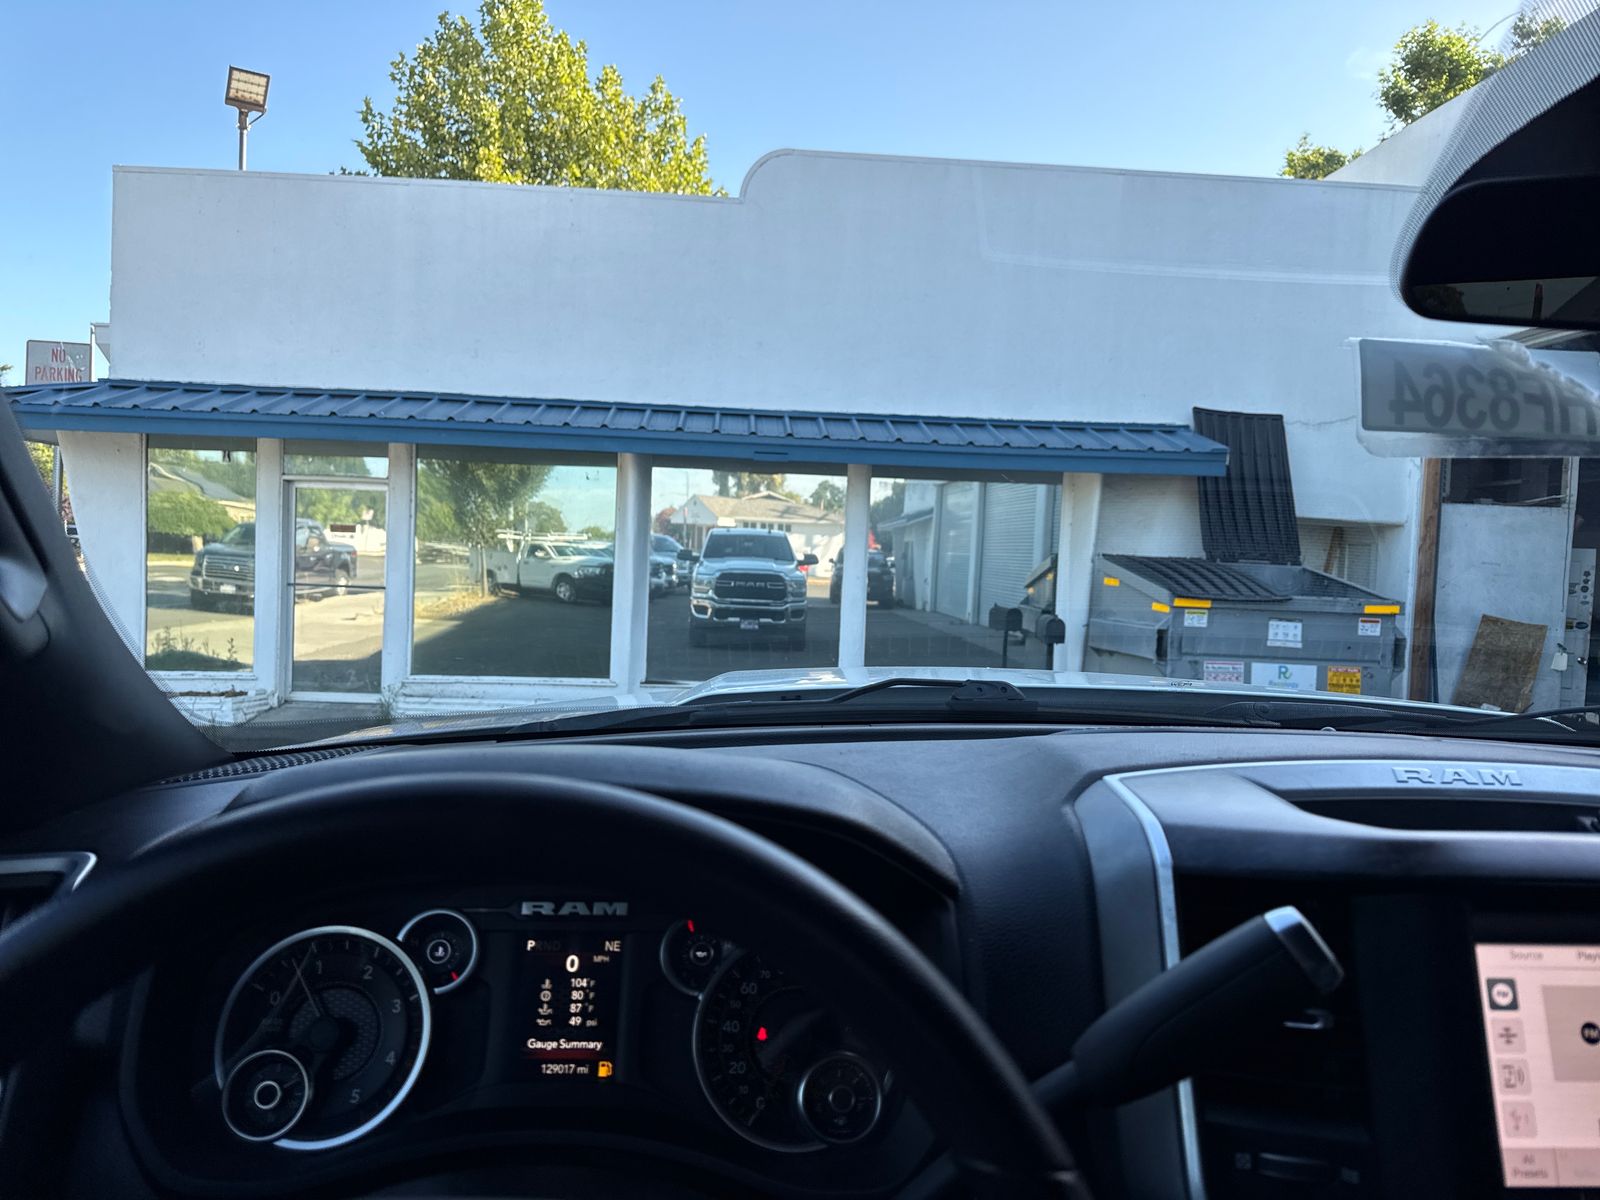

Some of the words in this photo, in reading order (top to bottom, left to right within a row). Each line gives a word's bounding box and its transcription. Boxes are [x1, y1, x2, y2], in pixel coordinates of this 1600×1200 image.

[51, 348, 66, 363] NO
[34, 366, 82, 382] PARKING
[1391, 766, 1523, 786] RAM
[521, 901, 628, 916] RAM
[604, 940, 622, 952] NE
[1509, 950, 1543, 960] Source
[565, 954, 580, 973] 0
[363, 965, 374, 980] 2
[740, 982, 758, 995] 60
[391, 999, 402, 1013] 3
[568, 1016, 582, 1026] 49
[722, 1020, 740, 1033] 40
[527, 1038, 558, 1050] Gauge
[559, 1038, 603, 1051] Summary
[385, 1051, 395, 1065] 4
[541, 1063, 575, 1075] 129017
[576, 1063, 589, 1075] mi
[729, 1061, 747, 1075] 20
[350, 1089, 361, 1104] 5
[1513, 1167, 1549, 1179] Presets
